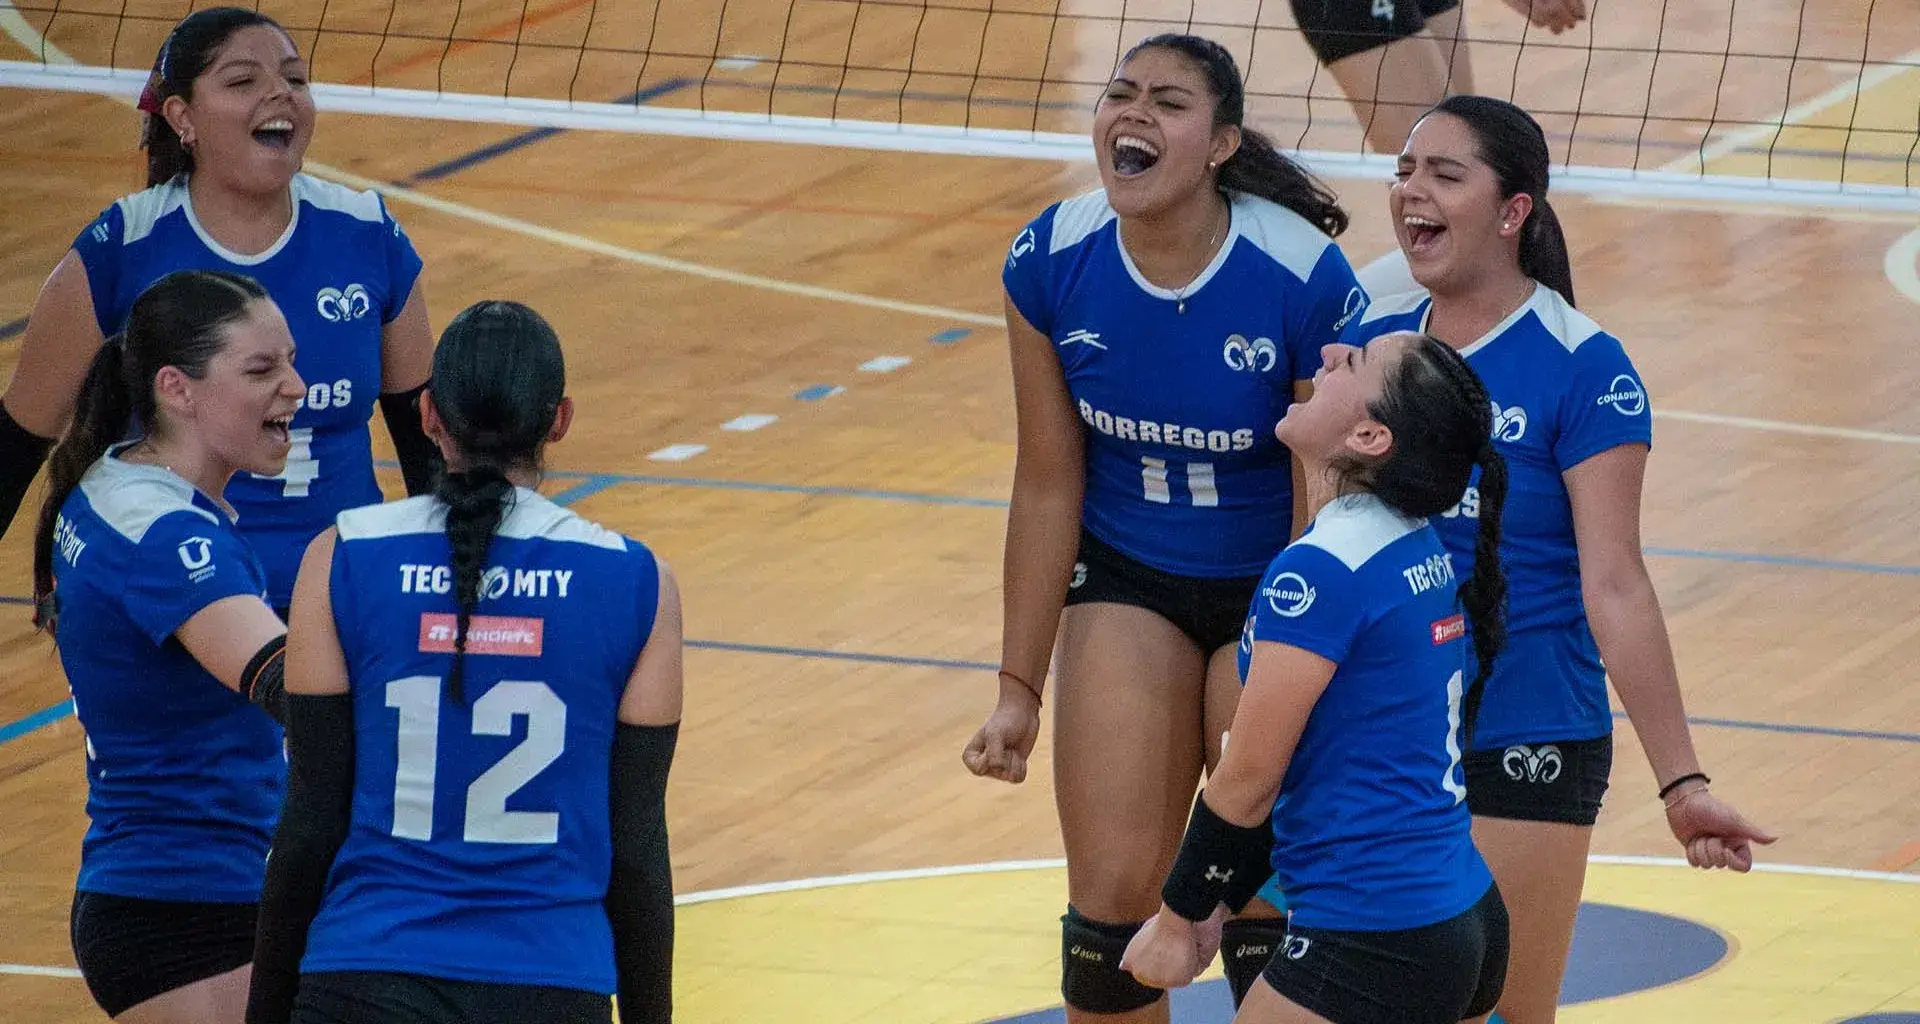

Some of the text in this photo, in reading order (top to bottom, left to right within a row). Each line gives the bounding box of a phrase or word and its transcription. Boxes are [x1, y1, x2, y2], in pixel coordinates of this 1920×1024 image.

[1079, 398, 1254, 452] BORREGOS
[1141, 456, 1219, 507] 11
[400, 564, 572, 598] TEC MTY
[1403, 564, 1431, 595] TEC
[452, 629, 535, 643] ANORTE
[385, 676, 567, 844] 12
